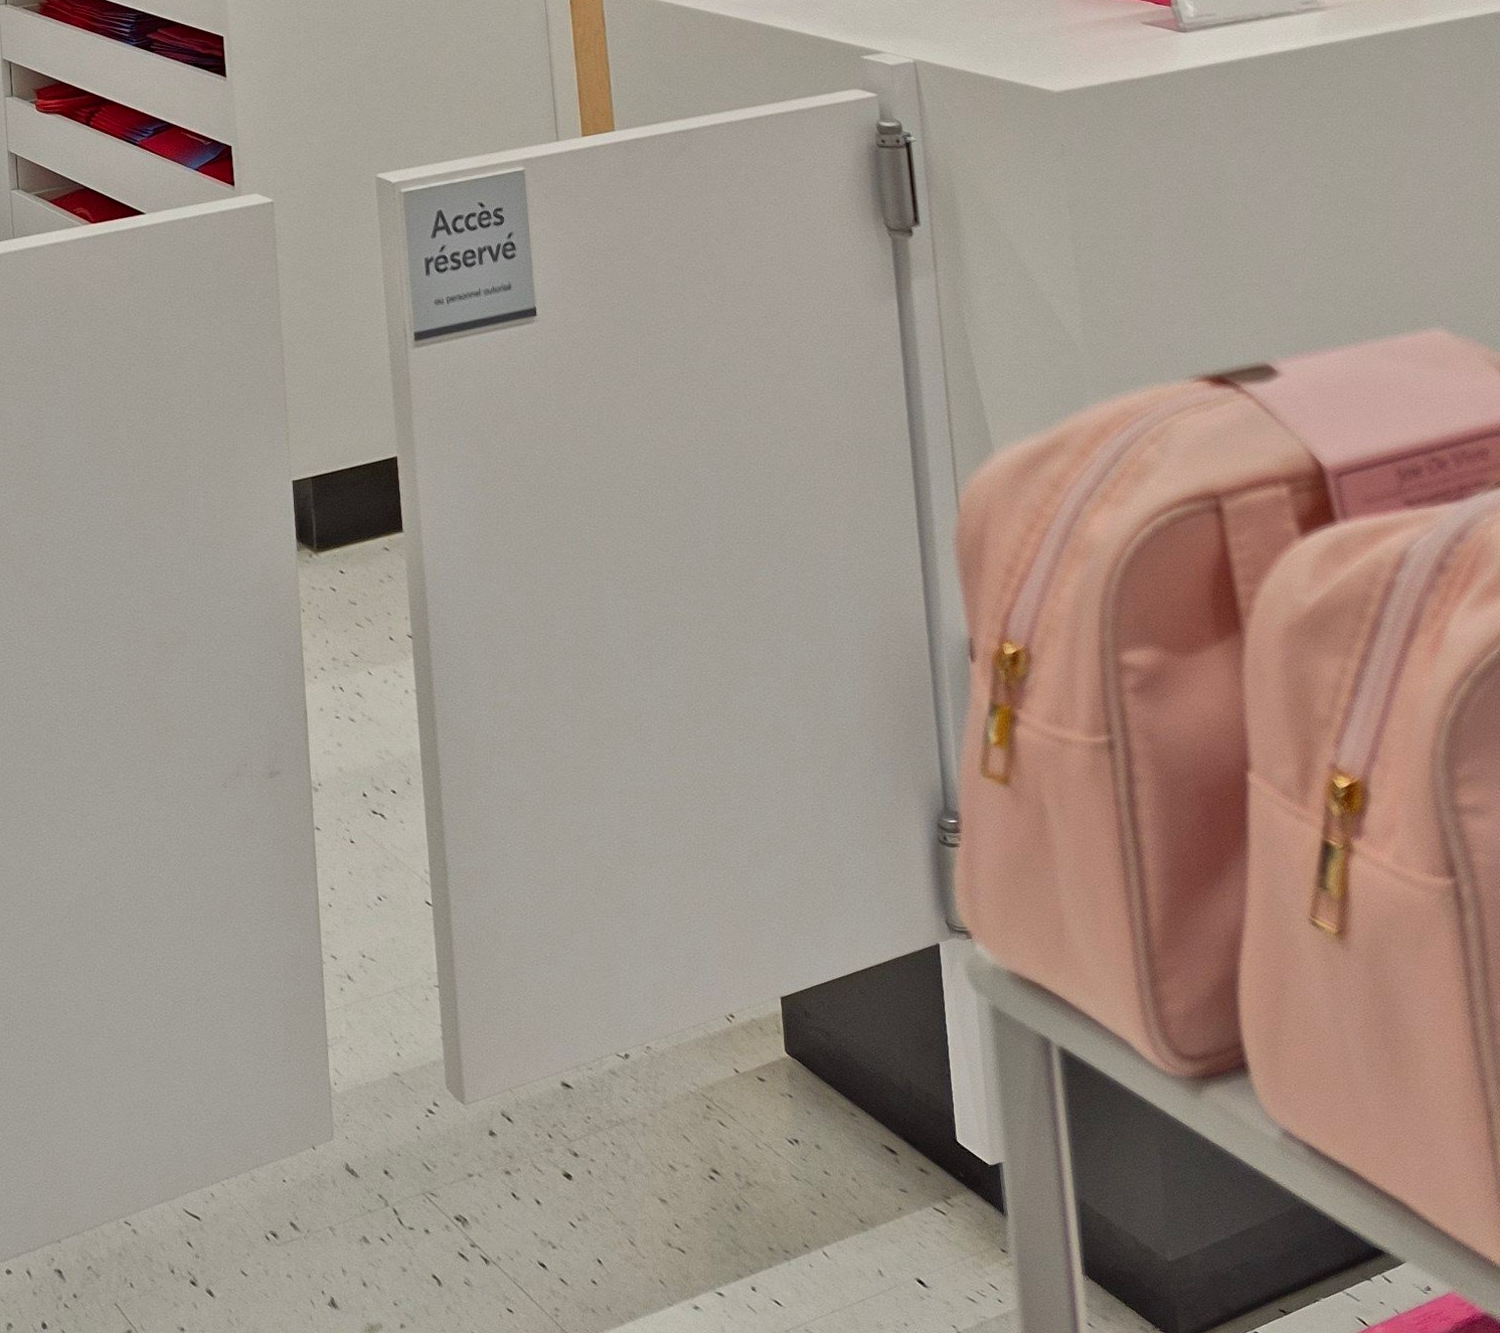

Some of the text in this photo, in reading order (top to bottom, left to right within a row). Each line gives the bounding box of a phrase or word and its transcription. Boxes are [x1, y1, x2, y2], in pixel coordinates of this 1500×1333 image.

[431, 201, 505, 239] Accès
[424, 231, 517, 277] réservé
[445, 288, 481, 305] personnel
